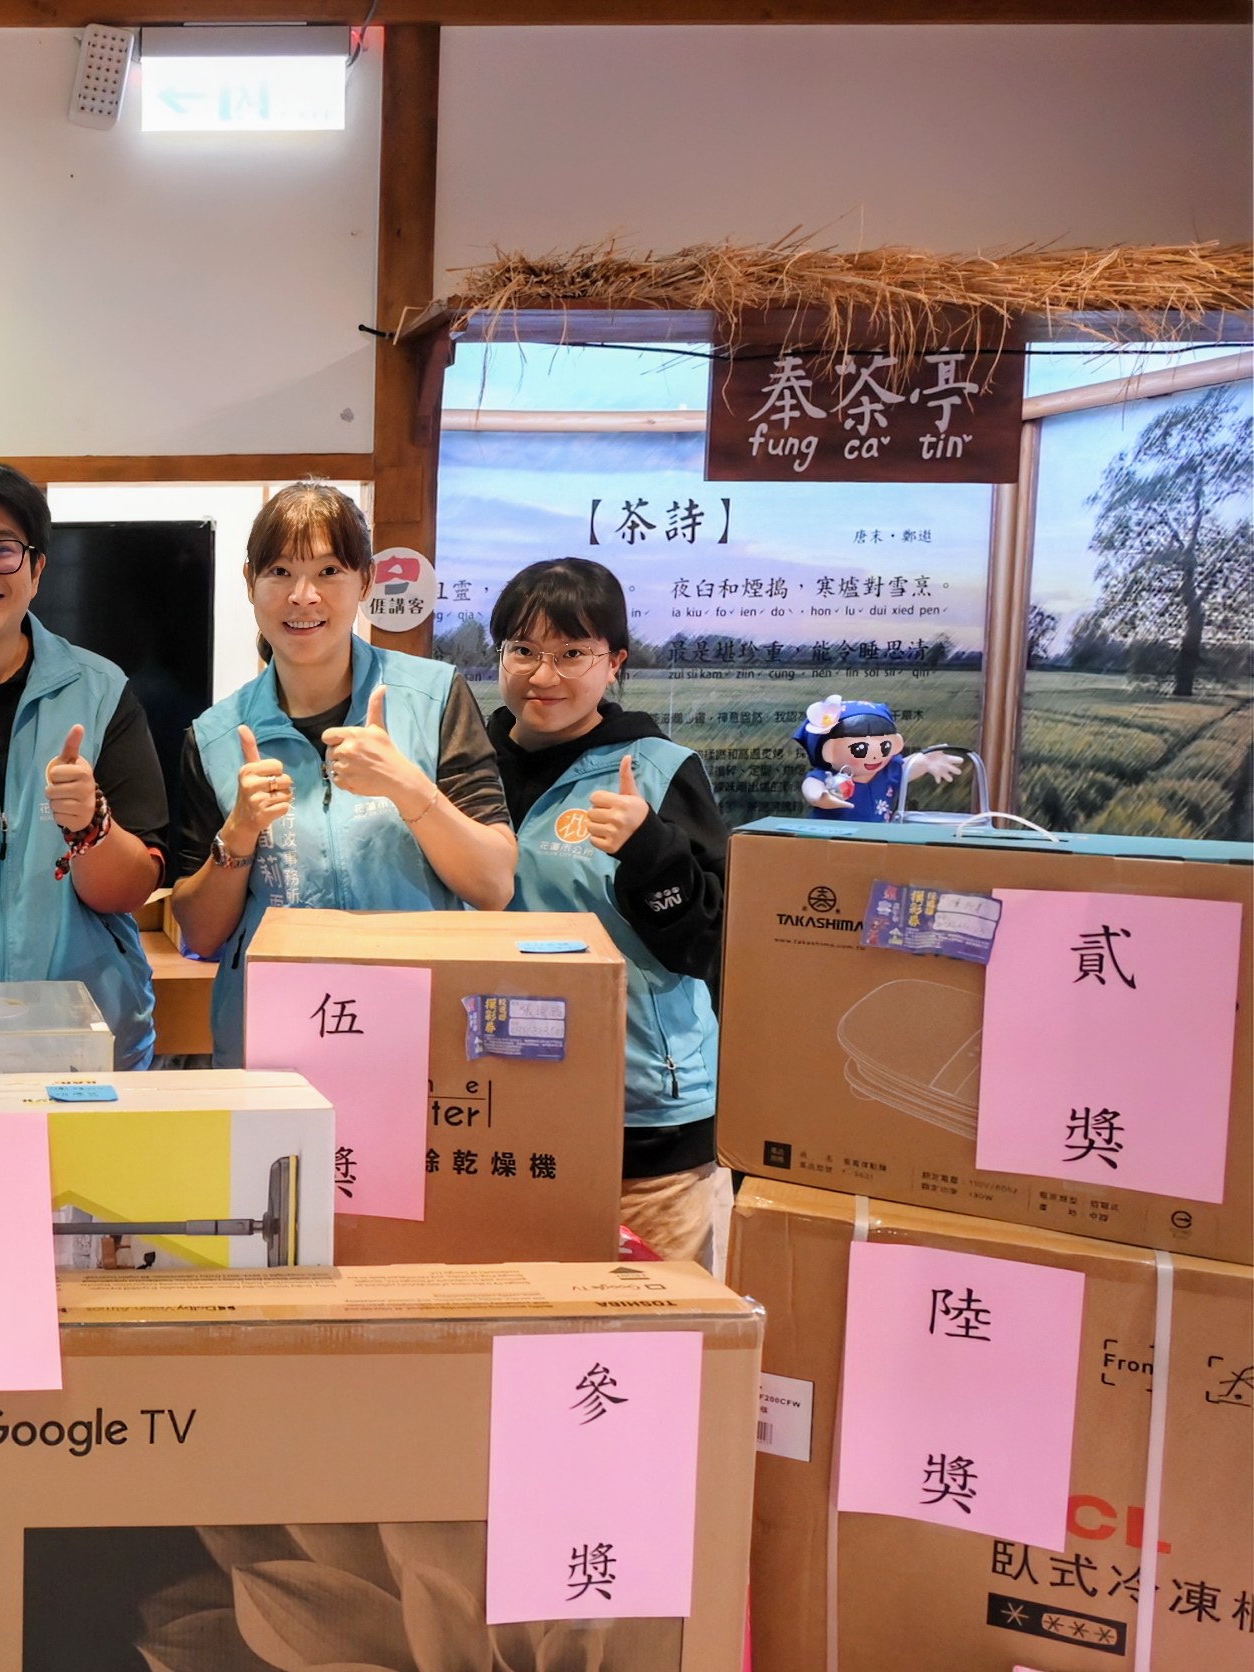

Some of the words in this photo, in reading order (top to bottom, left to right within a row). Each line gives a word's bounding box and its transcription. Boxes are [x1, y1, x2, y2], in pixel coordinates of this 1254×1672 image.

[748, 347, 979, 435] 奉茶亭
[748, 423, 819, 472] fung
[776, 913, 864, 932] TAKASHIMA
[310, 993, 364, 1038] 伍
[431, 1100, 480, 1127] ter
[1062, 1106, 1125, 1169] 獎
[928, 1288, 991, 1342] 陸
[1103, 1353, 1154, 1375] Fron
[569, 1361, 628, 1425] 參
[140, 1408, 197, 1445] TV
[919, 1453, 978, 1514] 獎
[1065, 1494, 1172, 1554] CL
[565, 1542, 617, 1602] 獎
